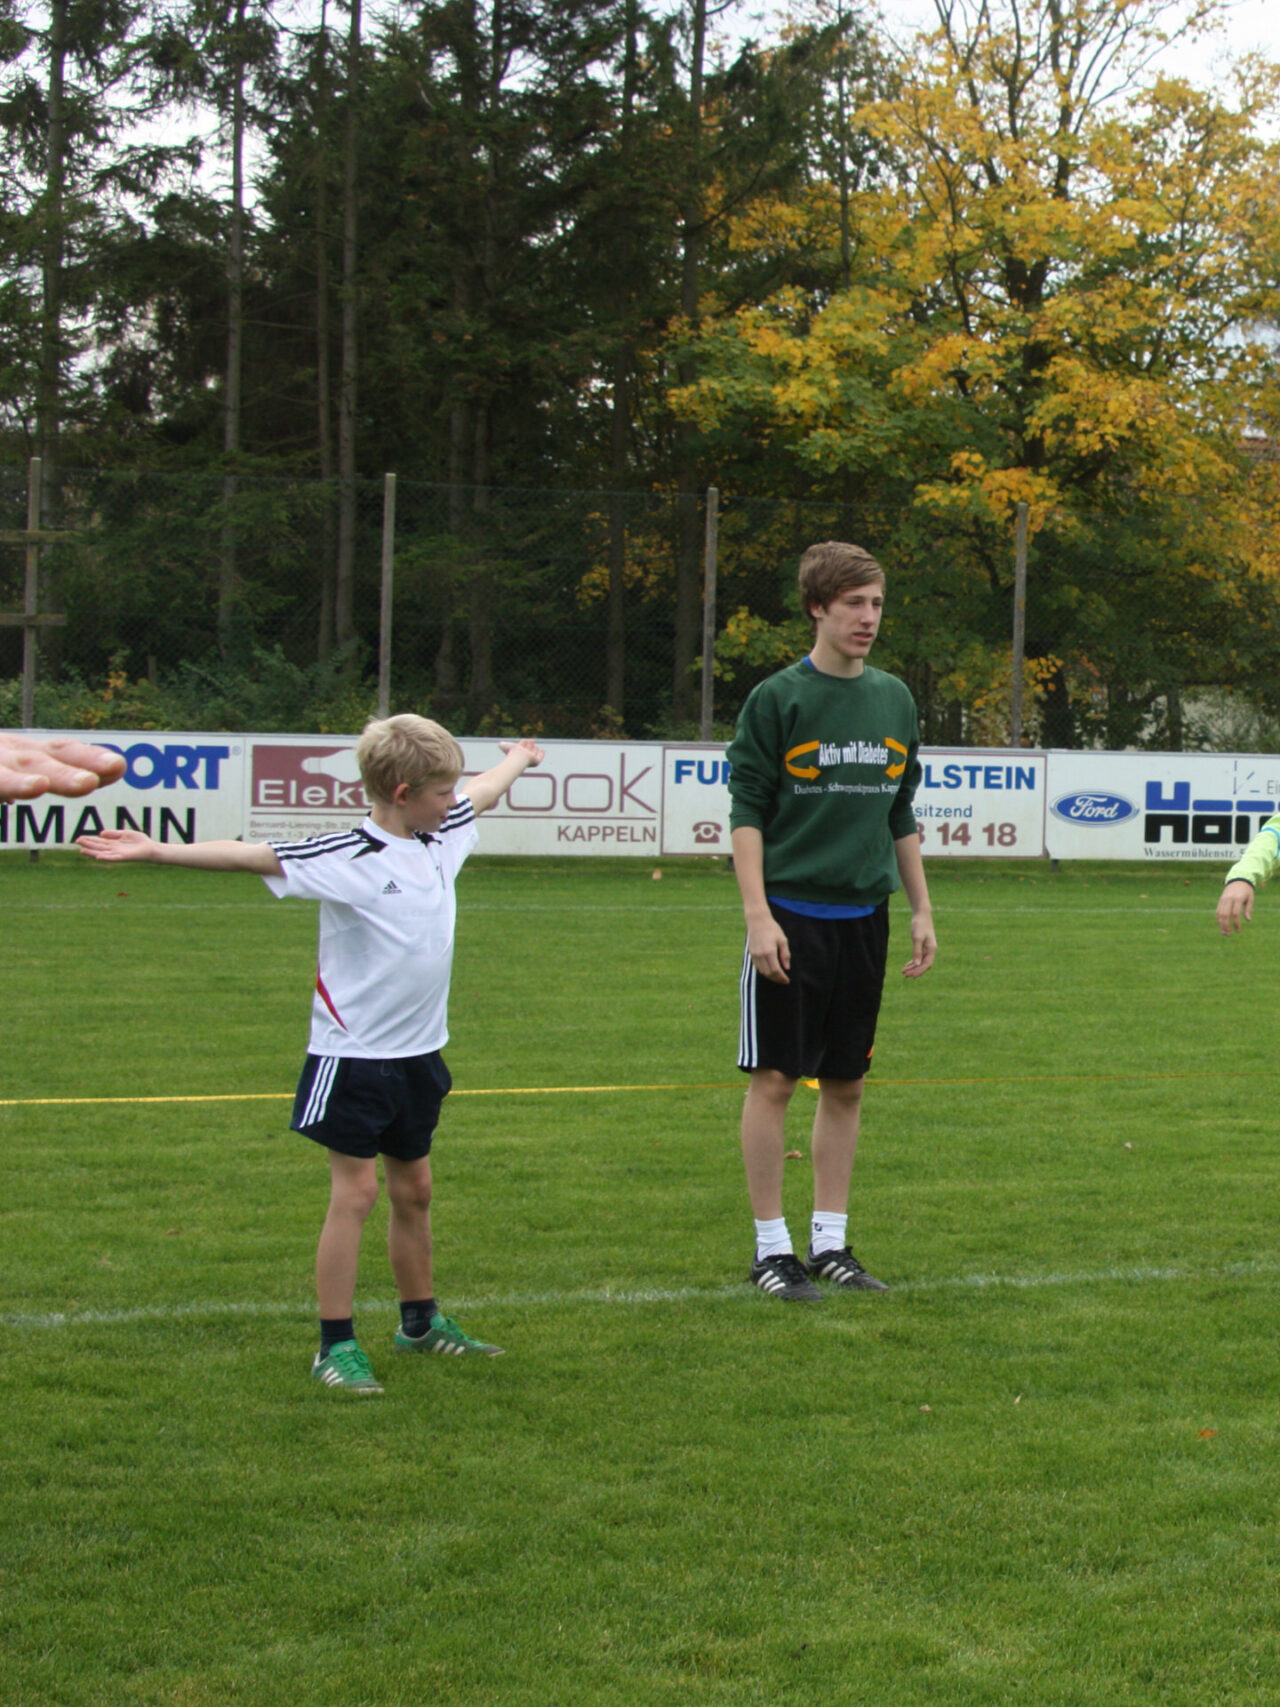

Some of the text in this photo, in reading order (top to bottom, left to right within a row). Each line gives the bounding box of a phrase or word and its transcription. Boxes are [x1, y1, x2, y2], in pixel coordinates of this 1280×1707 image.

[818, 740, 888, 766] Aktiv mit Diabetes
[89, 743, 229, 790] ORT
[464, 753, 656, 813] ook
[1070, 796, 1119, 818] Ford
[557, 825, 656, 842] KAPPELN
[936, 822, 972, 846] 14
[982, 822, 1017, 847] 18
[1144, 847, 1236, 858] Wassermühlenstr.
